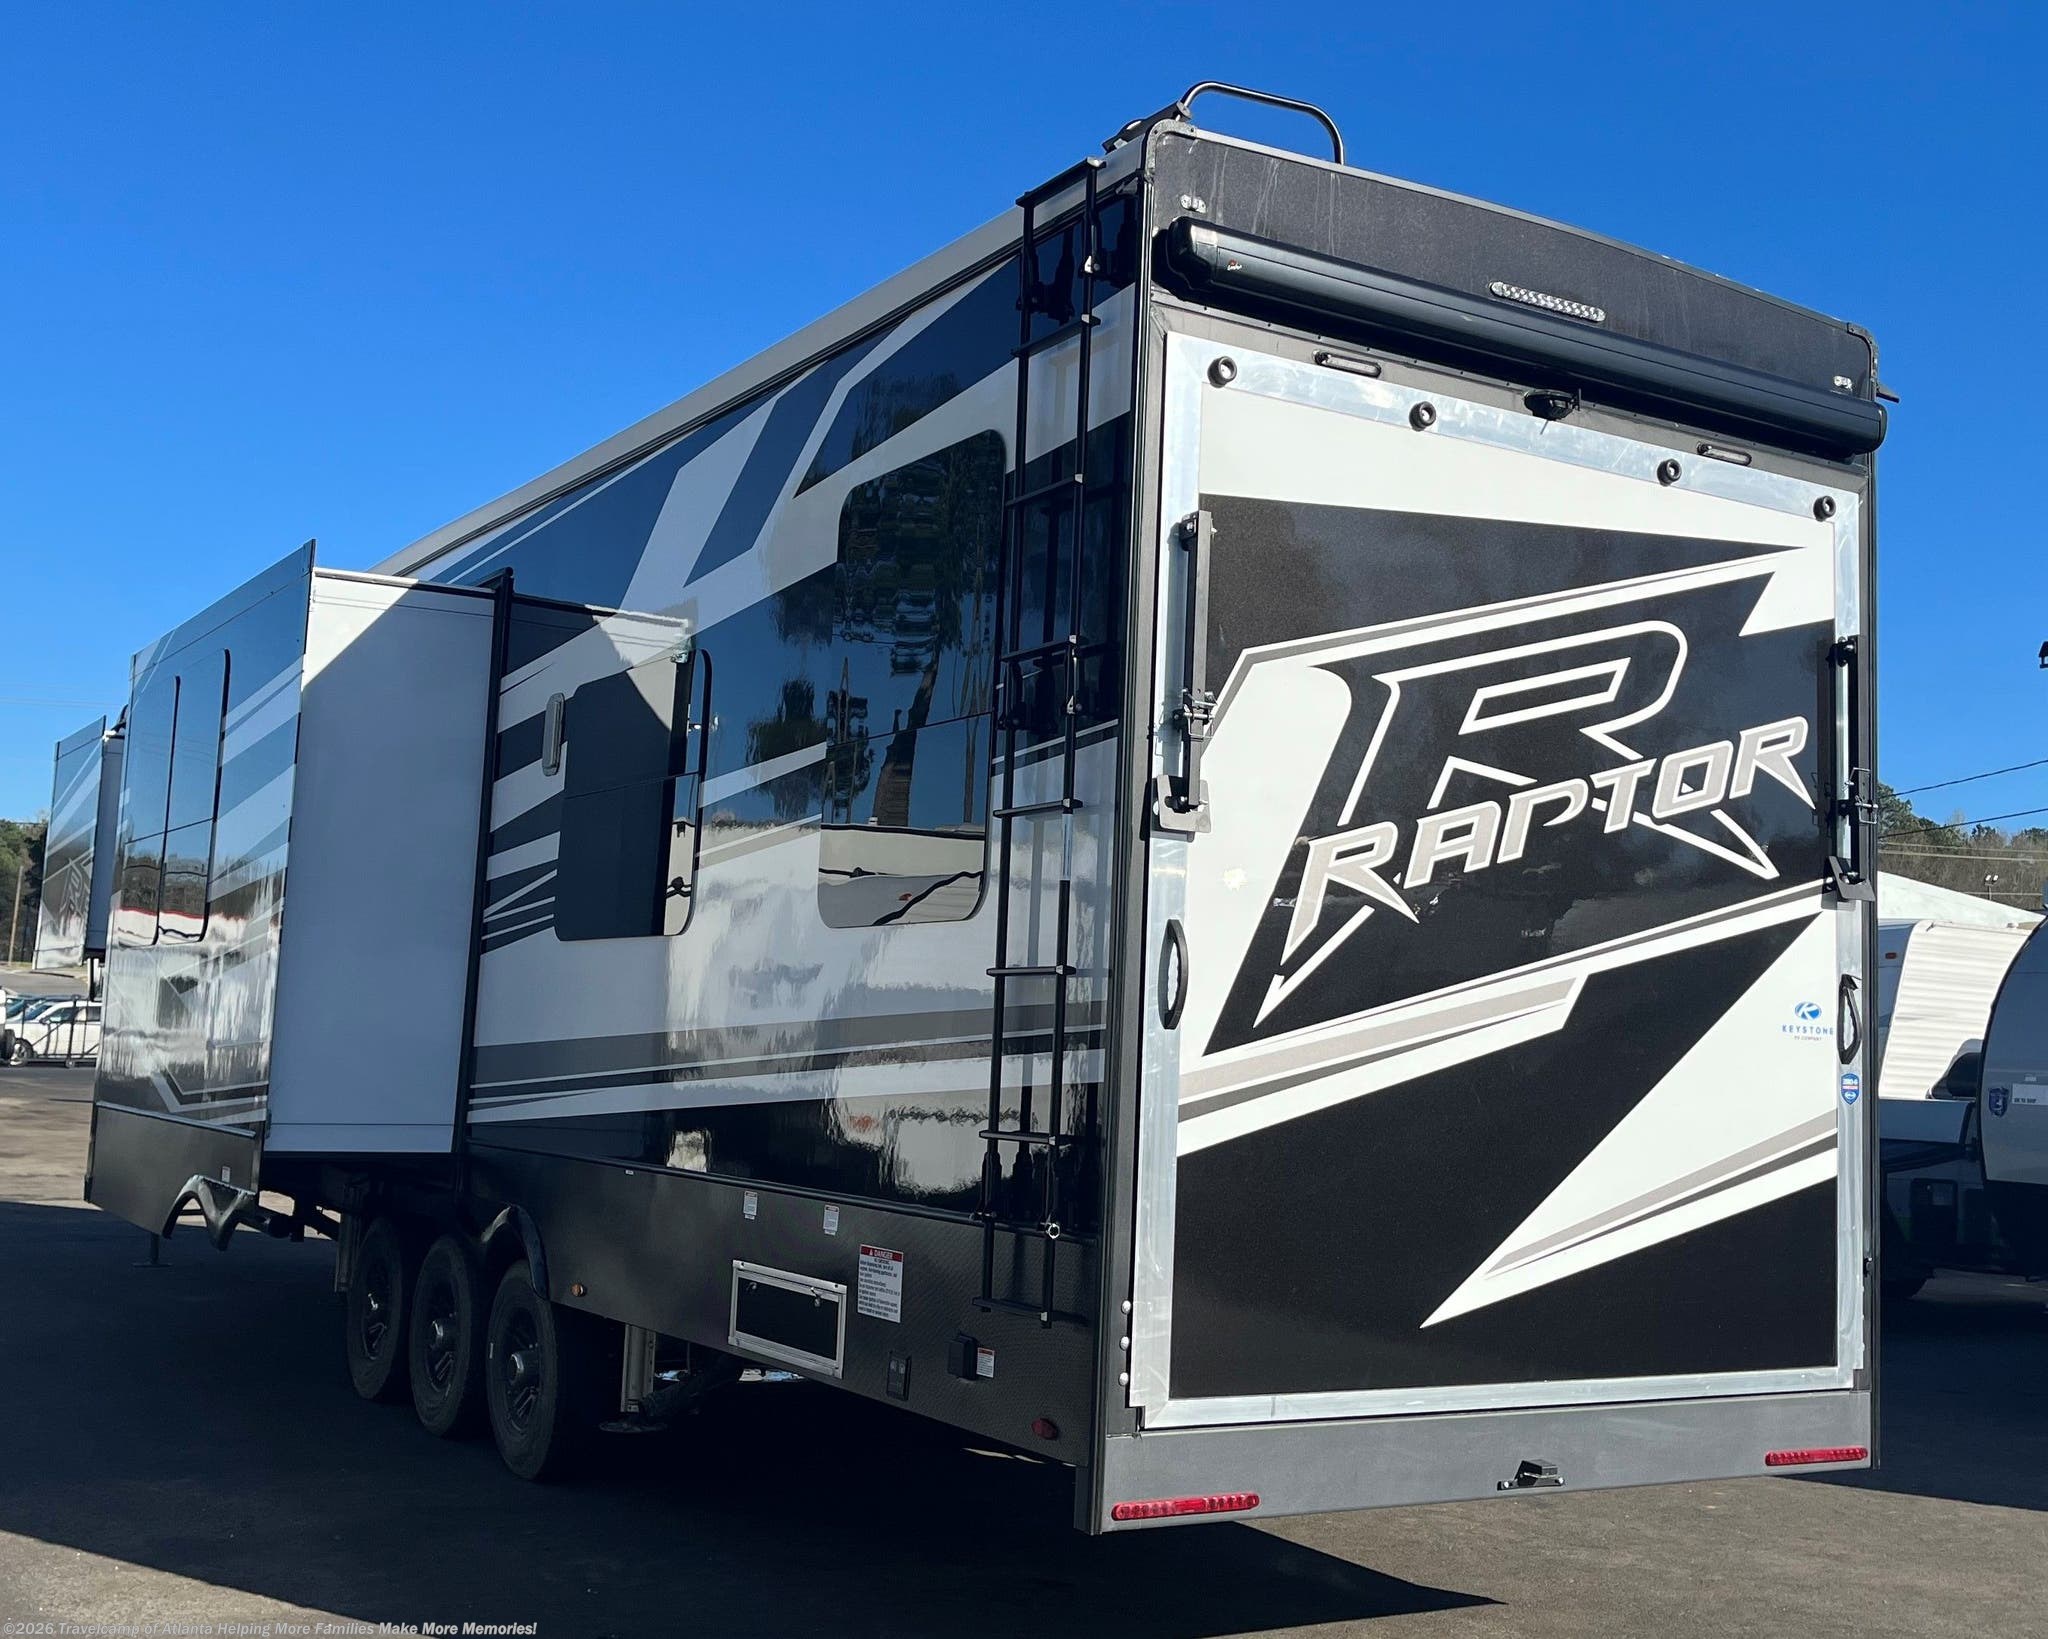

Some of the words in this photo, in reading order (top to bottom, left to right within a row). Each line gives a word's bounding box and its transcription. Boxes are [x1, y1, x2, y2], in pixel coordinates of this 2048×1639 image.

[1280, 715, 1816, 967] RAPTOR
[1782, 1024, 1834, 1035] KEYSTONE
[874, 1249, 893, 1259] DANGER
